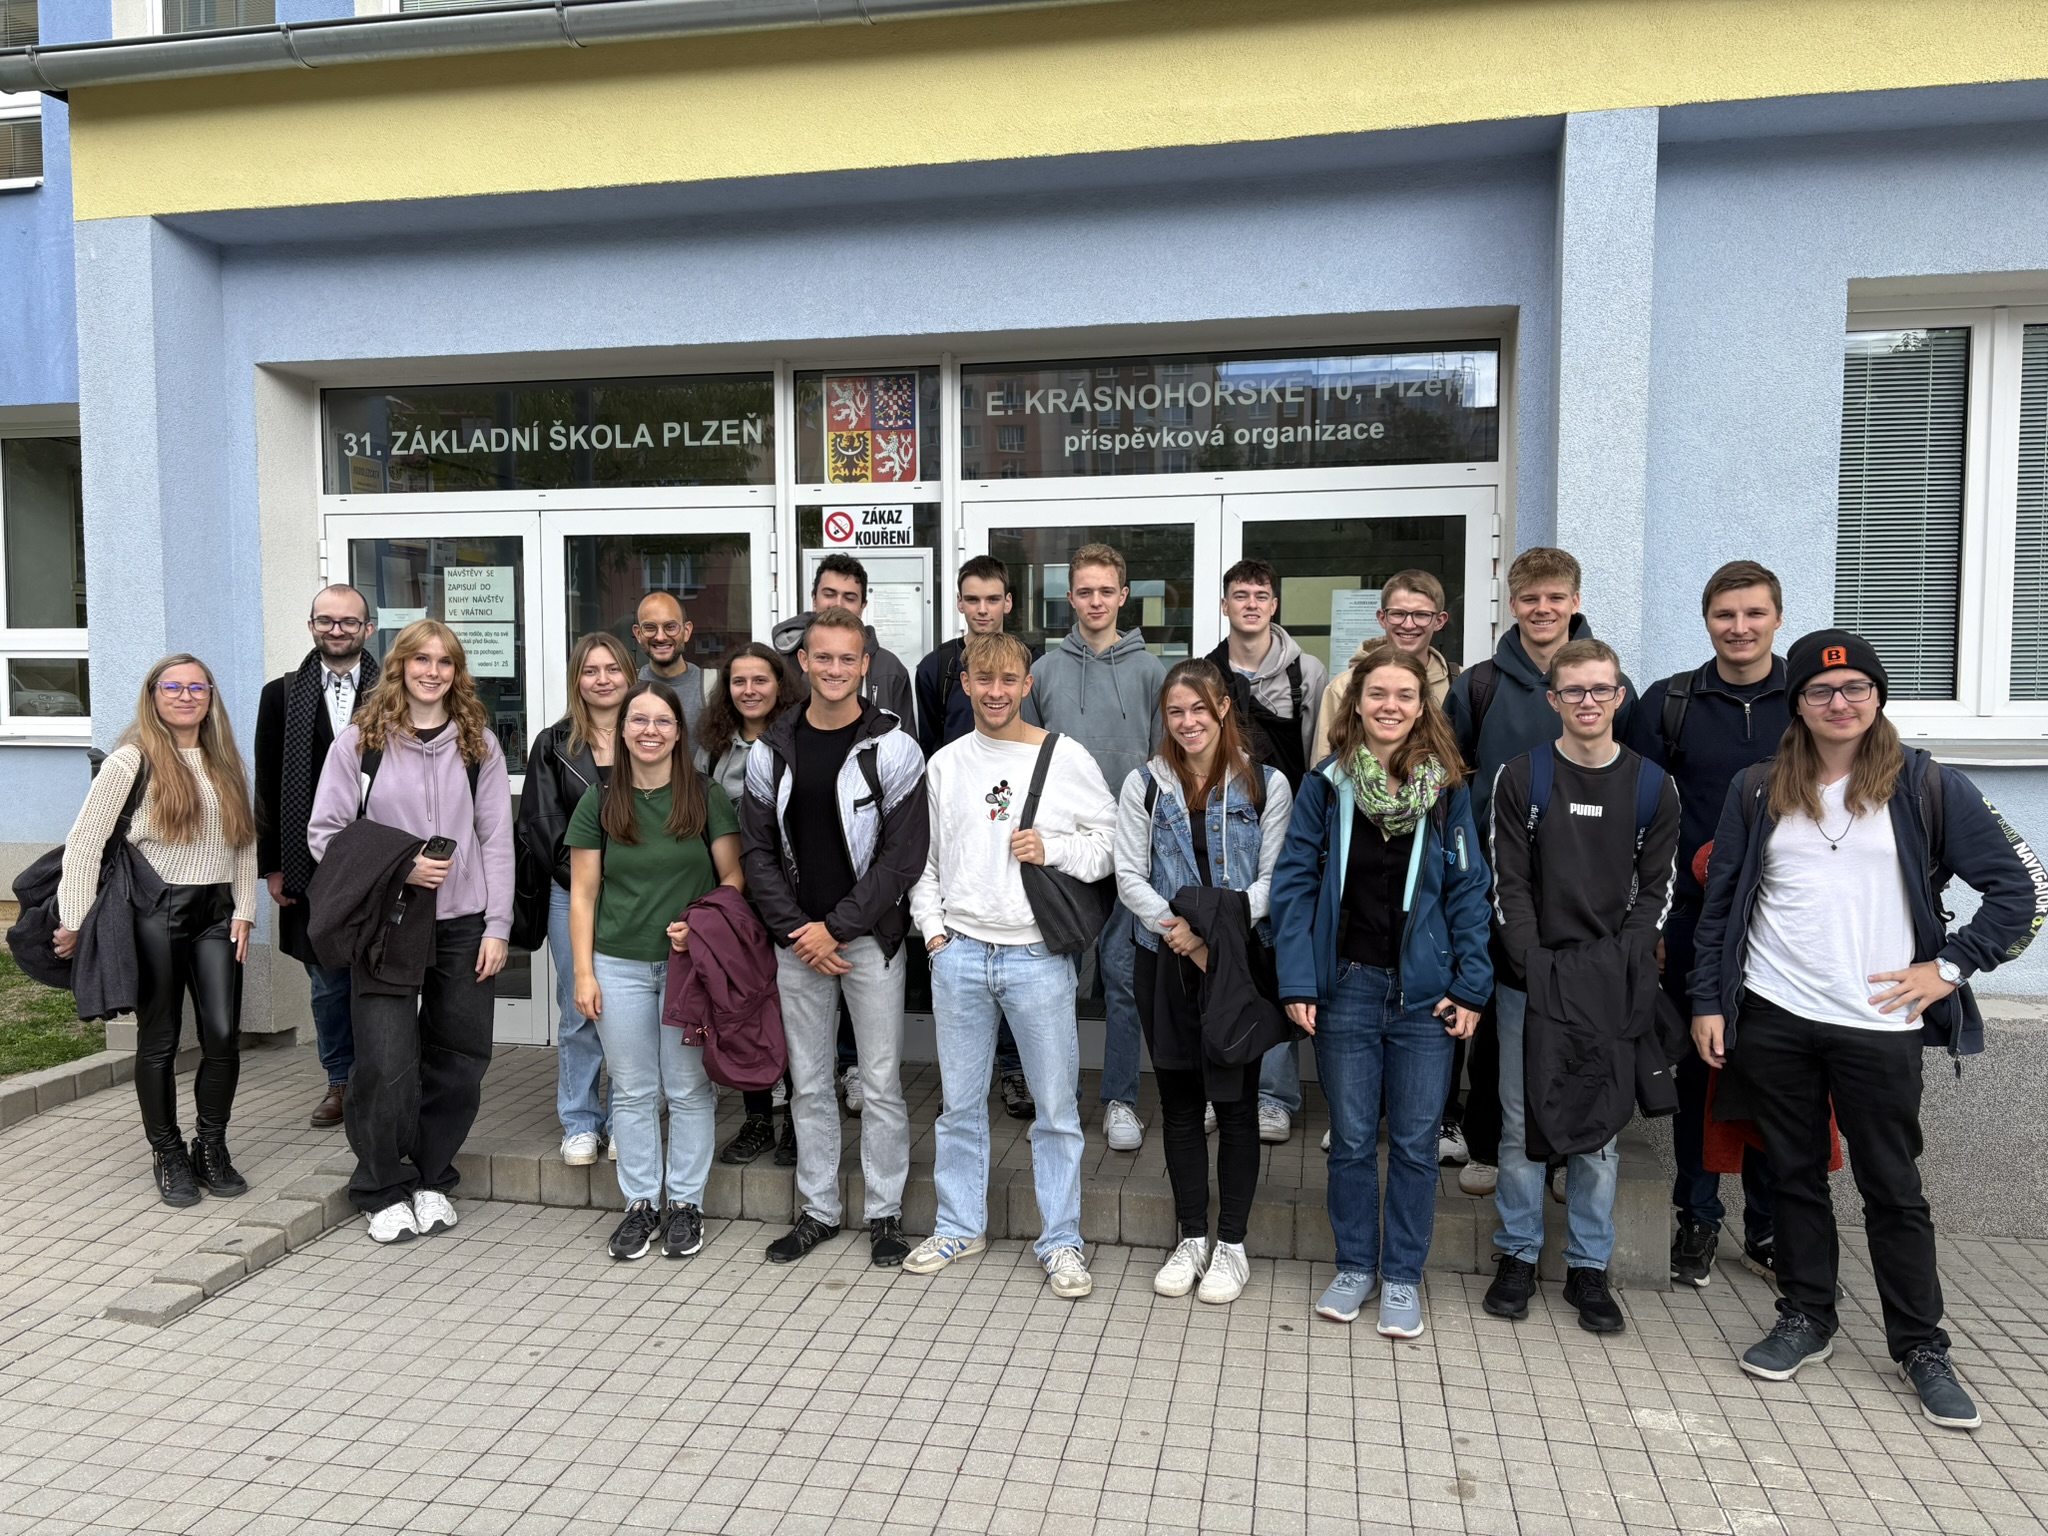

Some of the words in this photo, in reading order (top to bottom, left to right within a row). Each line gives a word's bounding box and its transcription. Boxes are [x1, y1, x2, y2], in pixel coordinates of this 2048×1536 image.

[986, 392, 1012, 416] E.
[1024, 373, 1305, 415] KRÁSNOHORSKÉ
[343, 432, 381, 457] 31.
[391, 420, 540, 456] ZÁKLADNÍ
[549, 419, 654, 451] ŠKOLA
[663, 412, 763, 447] PLZEŇ
[1063, 424, 1224, 457] příspěvková
[1233, 420, 1385, 449] organizace
[862, 507, 903, 525] ZÁKAZ
[855, 526, 912, 546] KOUŘENÍ
[448, 568, 482, 578] NÁVŠTĚVY
[448, 582, 476, 591] ZAPISUJÍ
[472, 594, 504, 603] NÁVŠTĚV
[460, 607, 493, 616] VRÁTNICI
[1828, 650, 1841, 660] B
[1570, 802, 1603, 817] PUMA
[2012, 841, 2048, 914] NAVIGATOR
